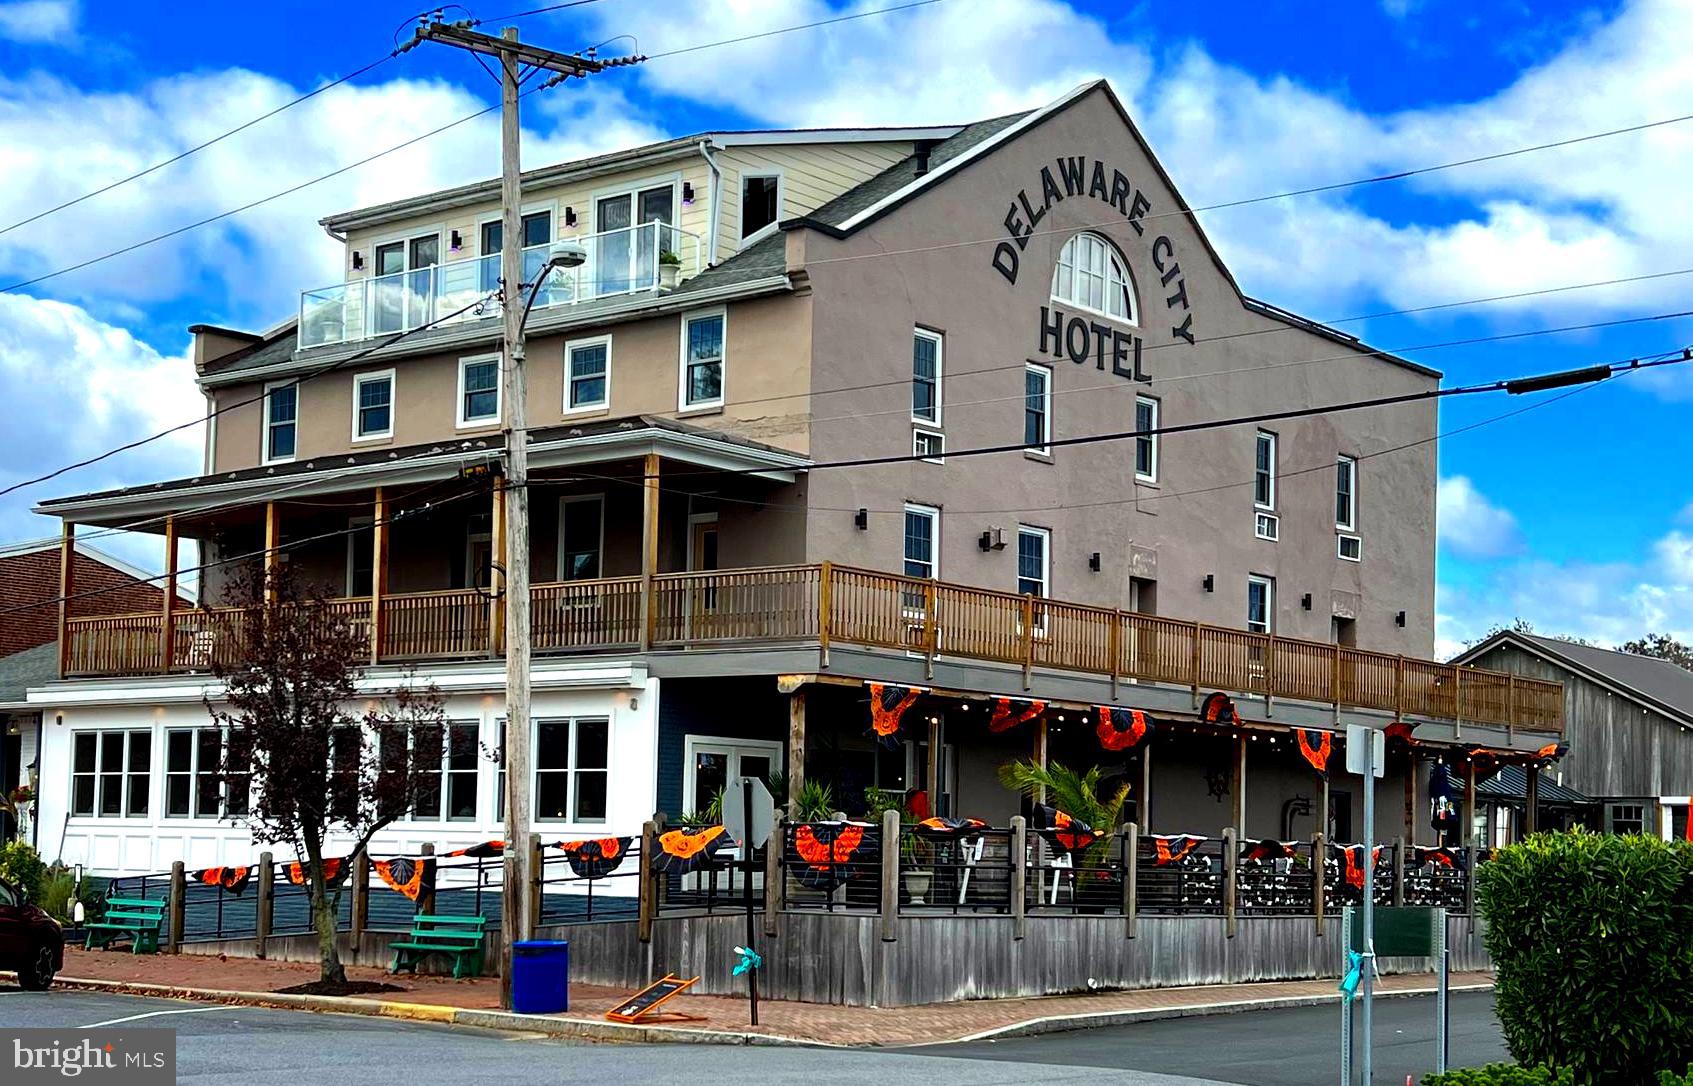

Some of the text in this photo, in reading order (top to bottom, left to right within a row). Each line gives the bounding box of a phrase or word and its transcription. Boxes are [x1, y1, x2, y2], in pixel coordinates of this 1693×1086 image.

[992, 156, 1195, 345] DELAWARE CITY
[1039, 306, 1152, 386] HOTEL
